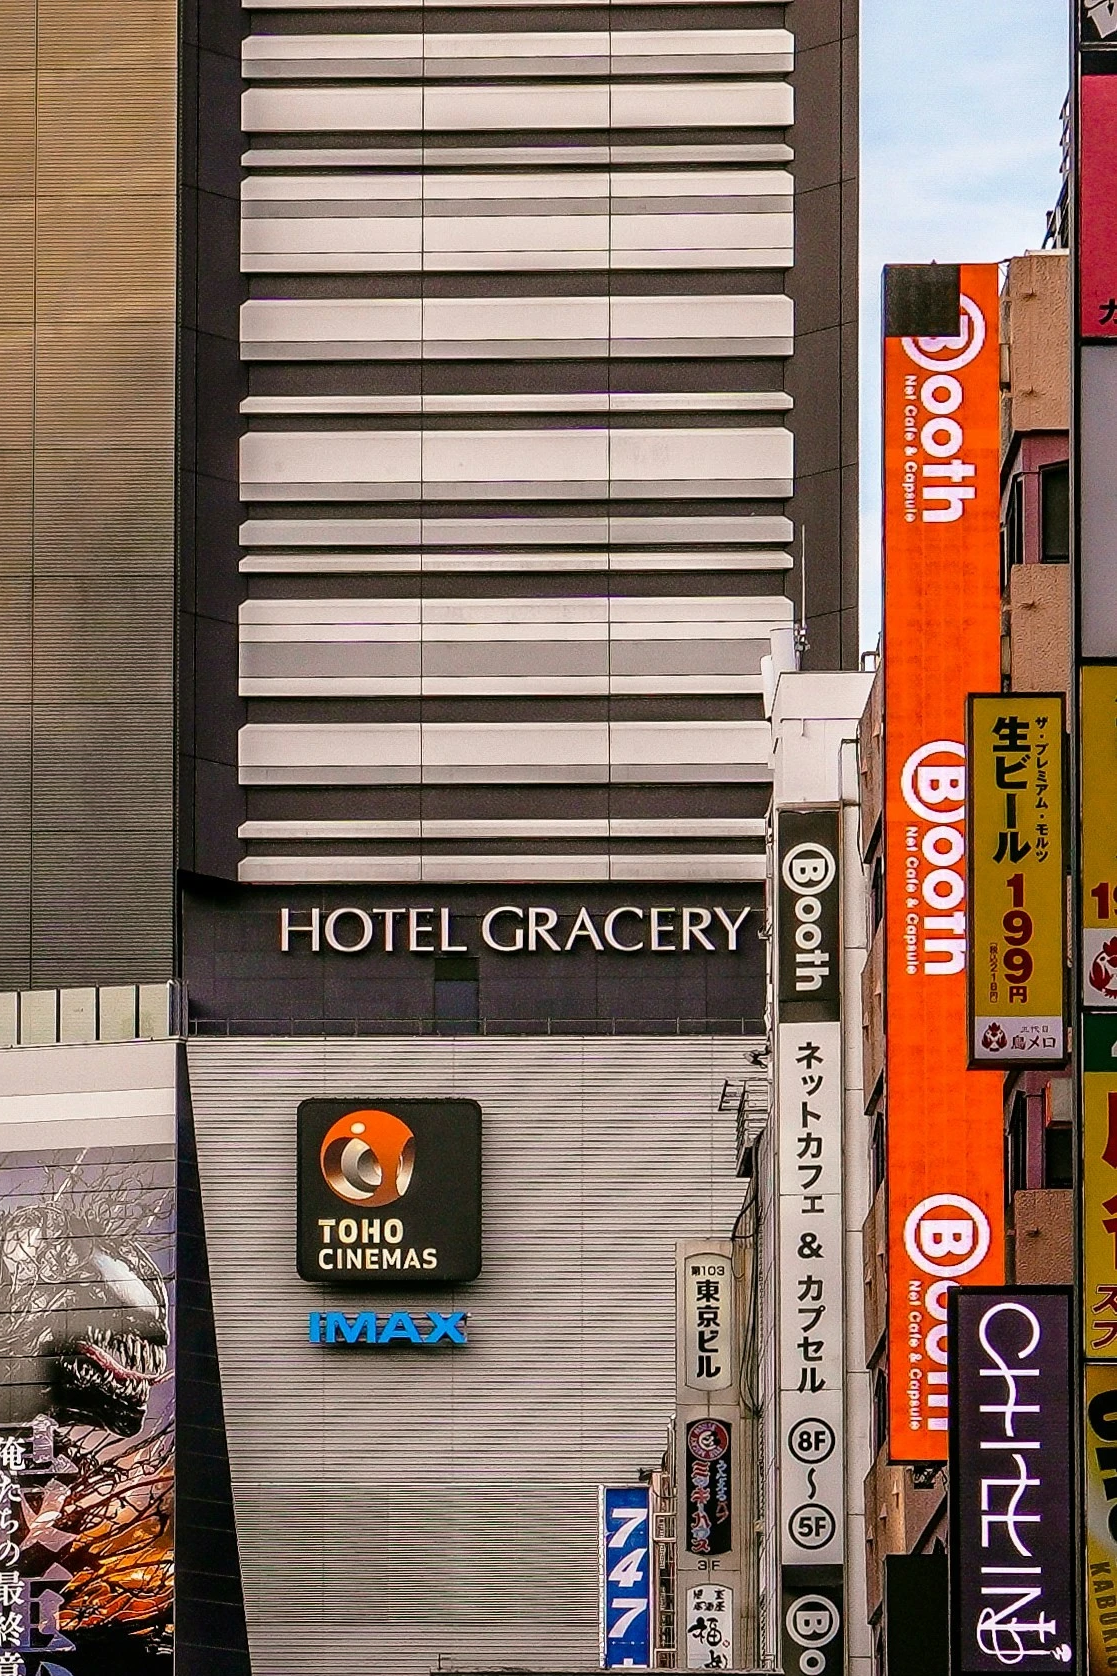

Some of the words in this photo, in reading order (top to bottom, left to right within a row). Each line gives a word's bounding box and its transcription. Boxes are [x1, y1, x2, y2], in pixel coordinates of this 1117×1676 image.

[903, 460, 919, 523] Capsule
[992, 715, 1033, 865] 生ビール
[1034, 715, 1050, 864] ザ・プレミアム・モルツ
[280, 907, 469, 953] HOTEL
[482, 905, 752, 953] GRACERY
[783, 842, 836, 992] Booth
[1002, 872, 1034, 1004] 199円
[795, 1042, 825, 1214] ネットカフェ
[318, 1218, 404, 1244] TOHO
[318, 1247, 438, 1270] CINEMAS
[797, 1232, 824, 1259] &
[307, 1311, 469, 1344] IMAX
[696, 1279, 722, 1379] 東京ビル
[795, 1274, 826, 1394] カプセル
[797, 1430, 827, 1453] 8F
[797, 1514, 827, 1539] 5F
[607, 1508, 650, 1641] 747
[697, 1560, 721, 1571] 3F
